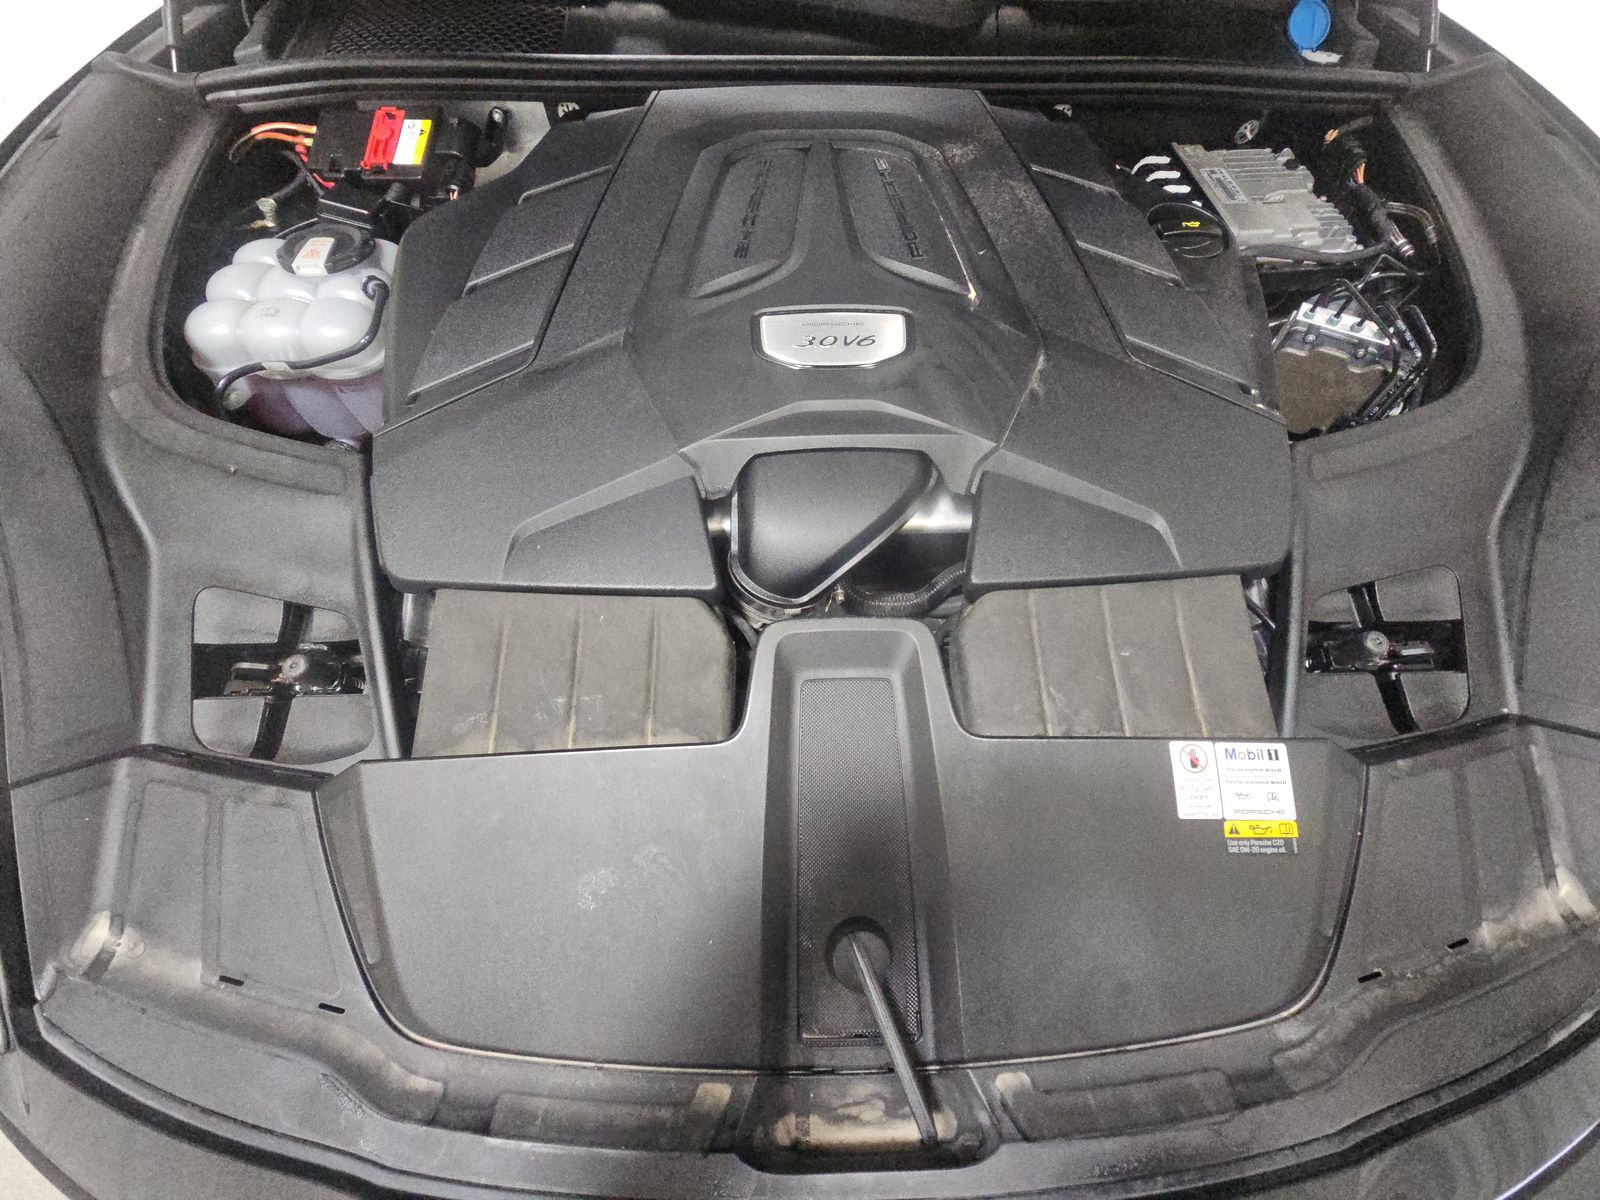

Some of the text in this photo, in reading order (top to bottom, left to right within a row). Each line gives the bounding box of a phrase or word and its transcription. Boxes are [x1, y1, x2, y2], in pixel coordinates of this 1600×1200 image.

[874, 157, 925, 260] PORSCHE
[843, 334, 876, 348] V6
[1224, 747, 1280, 761] Mobil 1
[1239, 839, 1250, 847] only
